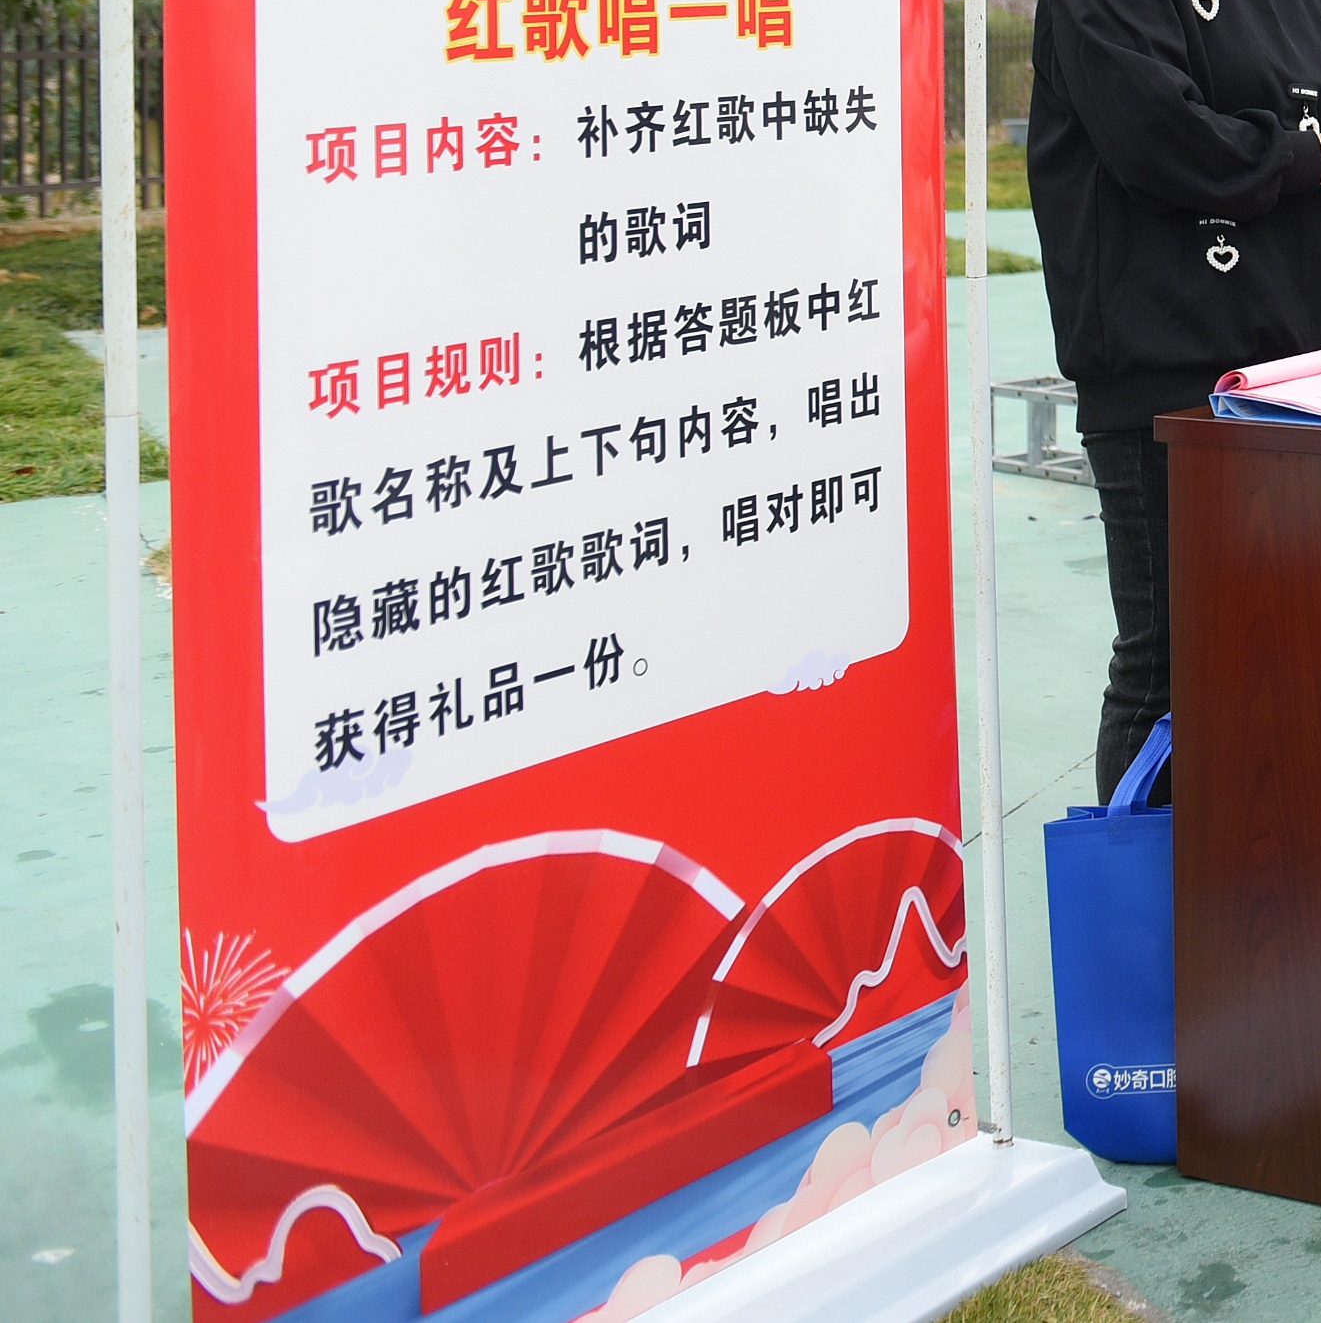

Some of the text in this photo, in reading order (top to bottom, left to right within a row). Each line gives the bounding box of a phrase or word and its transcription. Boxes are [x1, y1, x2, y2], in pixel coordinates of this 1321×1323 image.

[579, 201, 712, 265] 的歌词
[308, 372, 882, 539] 歌名称及上下句内容，唱出
[312, 465, 883, 658] 隐藏的红歌歌词，唱对即可
[313, 633, 651, 773] 获得礼品一份。
